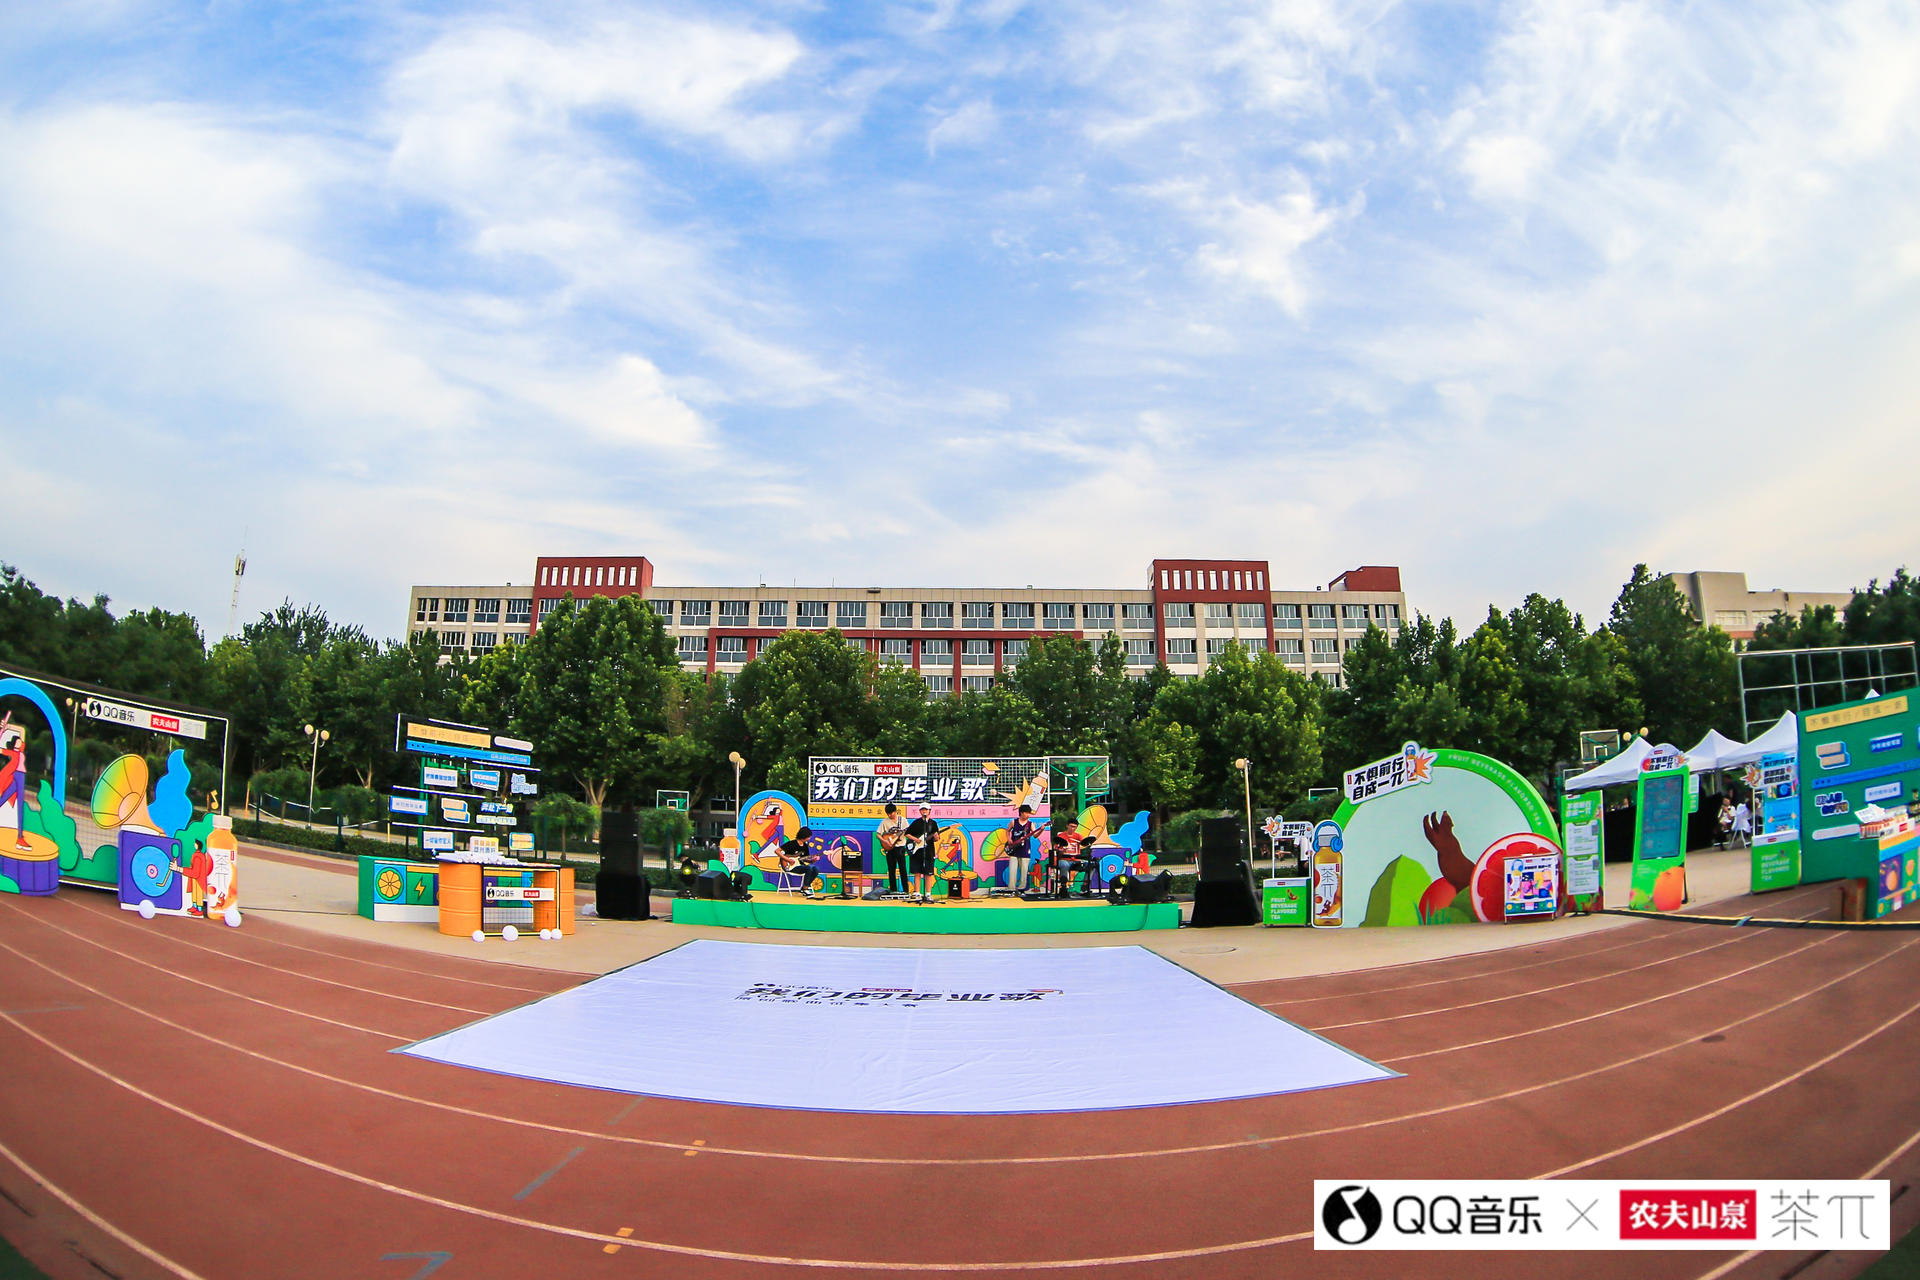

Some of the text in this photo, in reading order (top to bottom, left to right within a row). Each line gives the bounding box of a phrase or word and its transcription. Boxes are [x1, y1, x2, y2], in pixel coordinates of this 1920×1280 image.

[103, 705, 135, 722] QQ音乐
[829, 764, 860, 774] QQ音乐
[1354, 756, 1405, 785] 不惧前行
[814, 776, 989, 801] 我们的毕业歌
